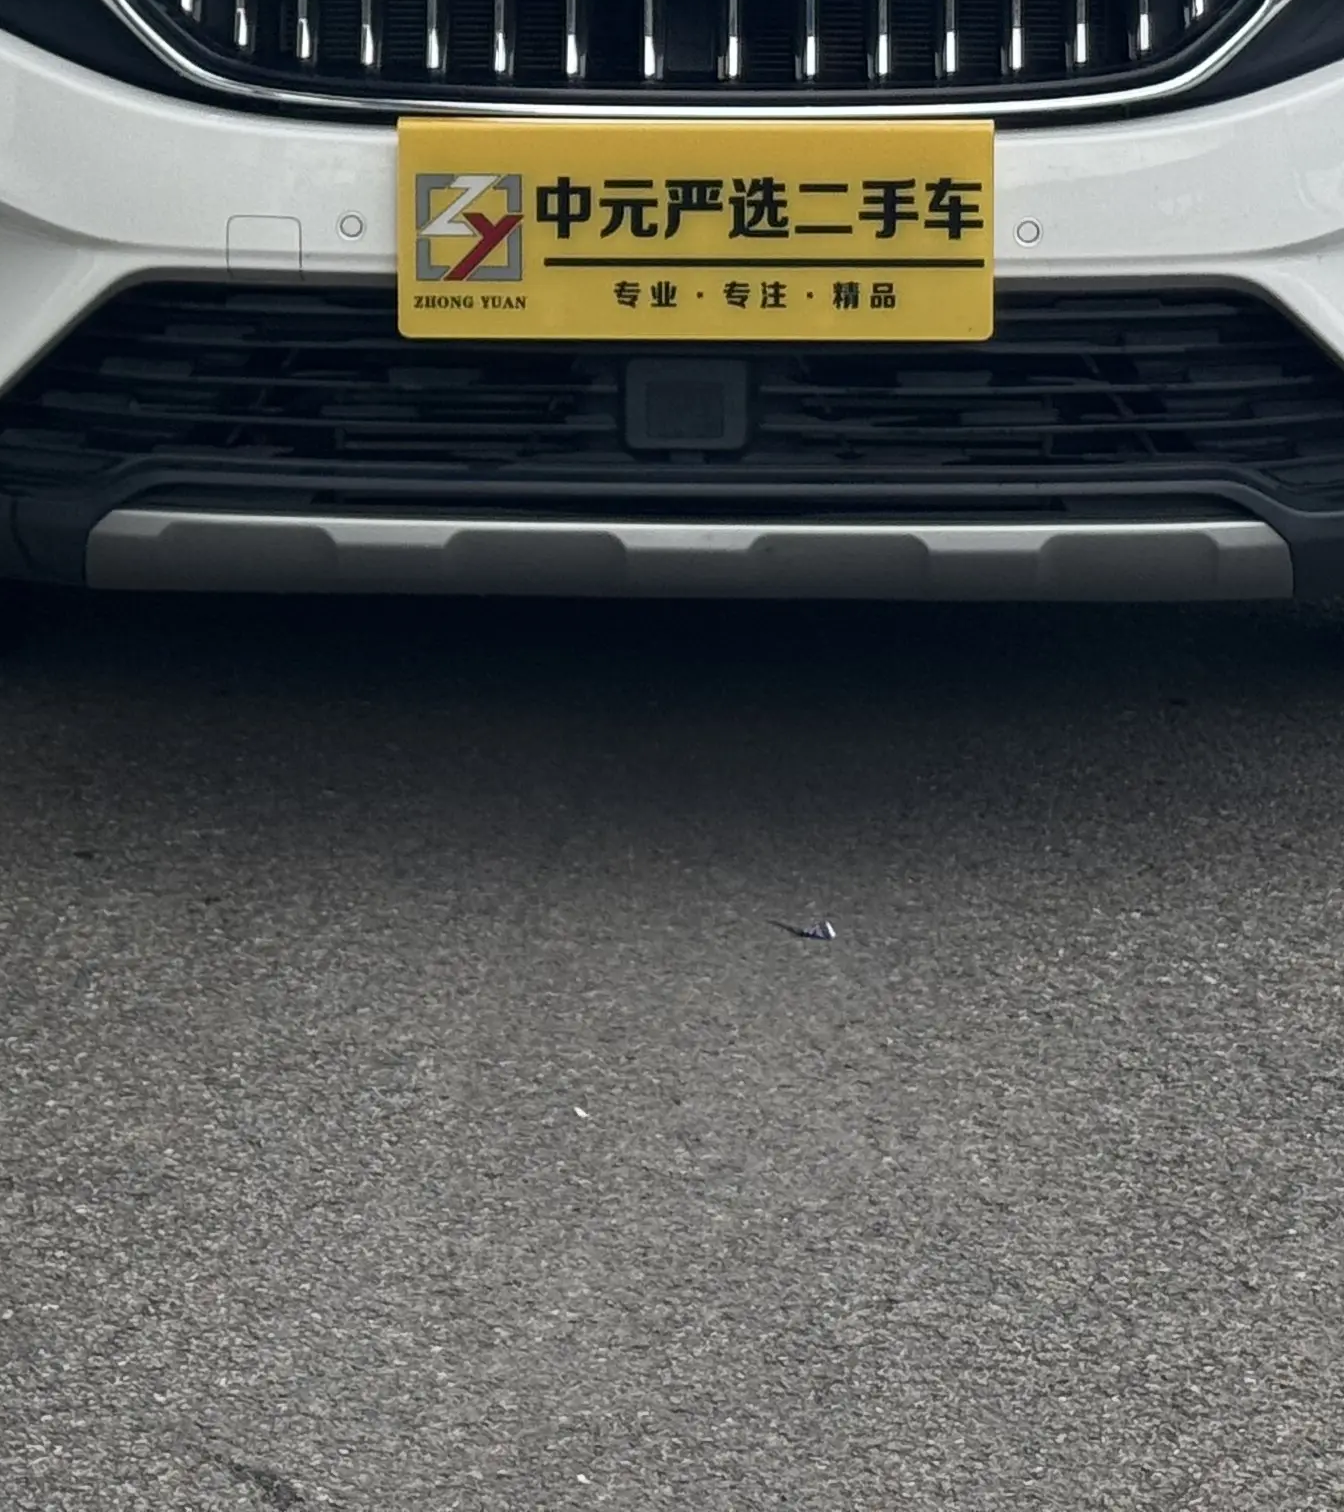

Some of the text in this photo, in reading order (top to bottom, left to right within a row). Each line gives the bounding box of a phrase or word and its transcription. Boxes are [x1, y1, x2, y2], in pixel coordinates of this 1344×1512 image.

[535, 176, 984, 241] 中元严选二手车
[413, 294, 527, 310] ZHONG YUAN
